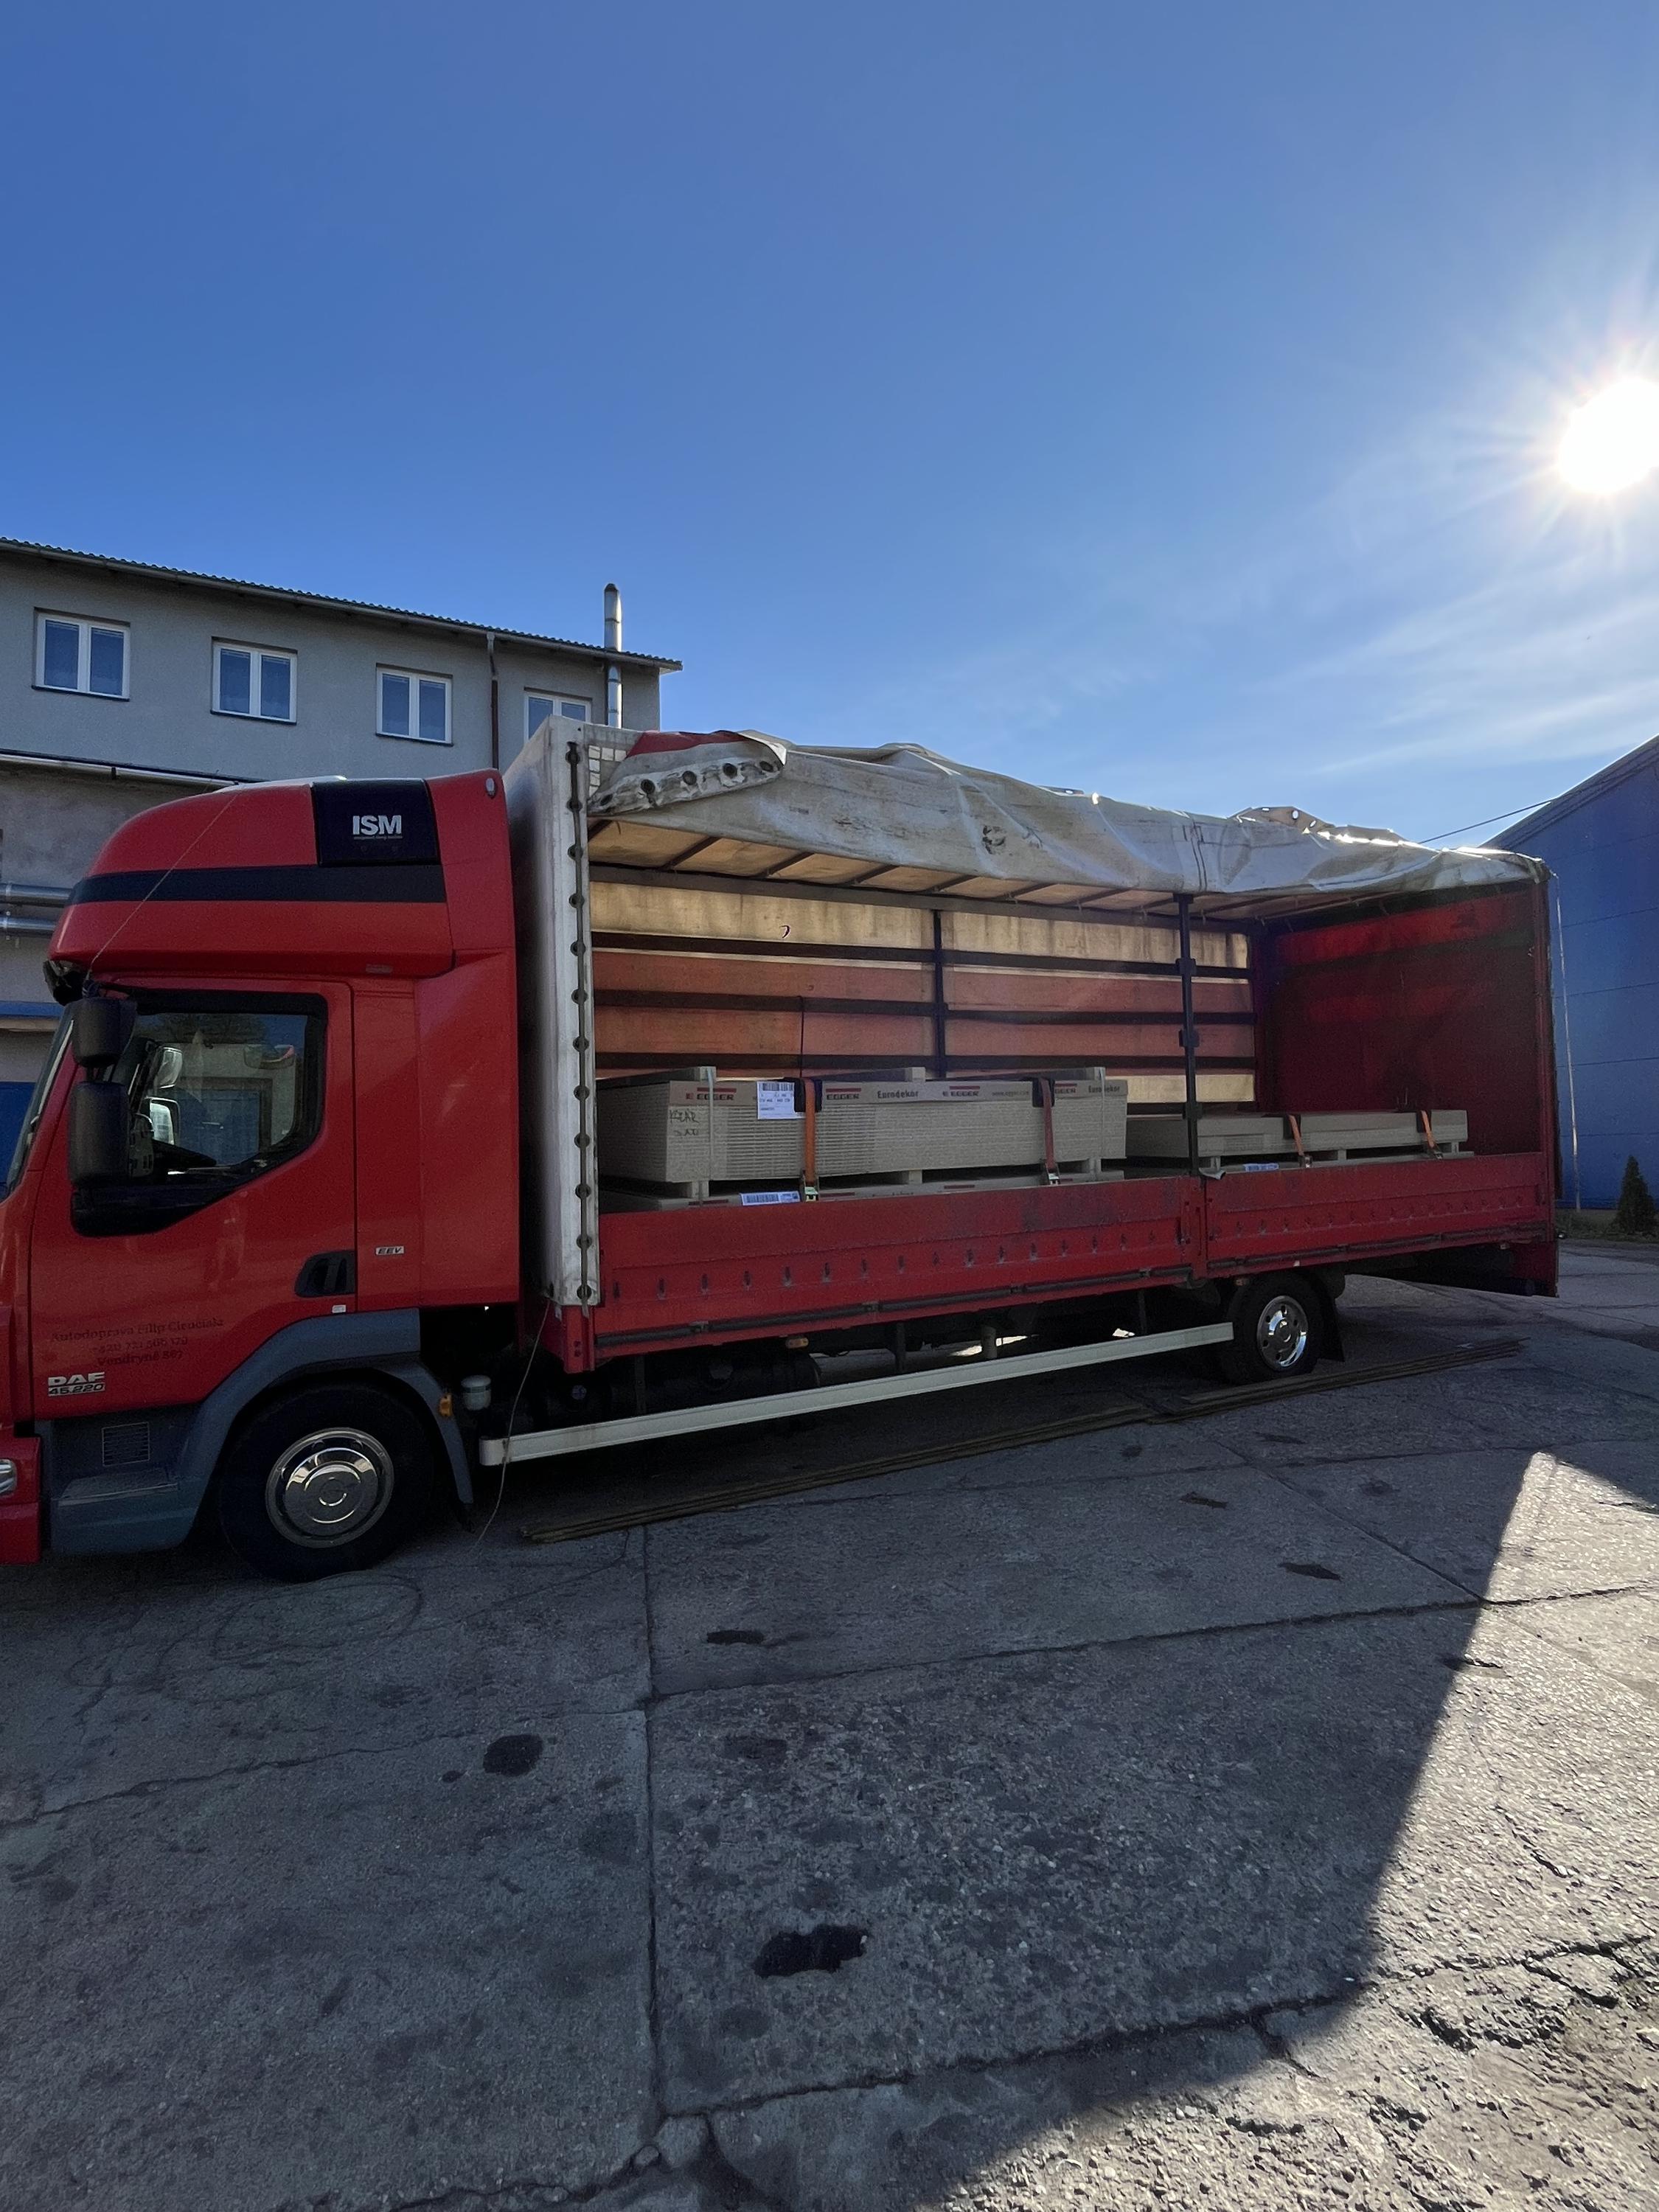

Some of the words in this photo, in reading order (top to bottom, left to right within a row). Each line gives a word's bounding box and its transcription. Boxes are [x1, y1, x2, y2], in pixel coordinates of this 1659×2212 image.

[352, 815, 402, 835] ISM
[877, 1090, 919, 1099] Eurodekor
[52, 1326, 133, 1343] Autodoprava
[48, 1372, 105, 1386] DAF
[49, 1383, 104, 1396] 45.220
